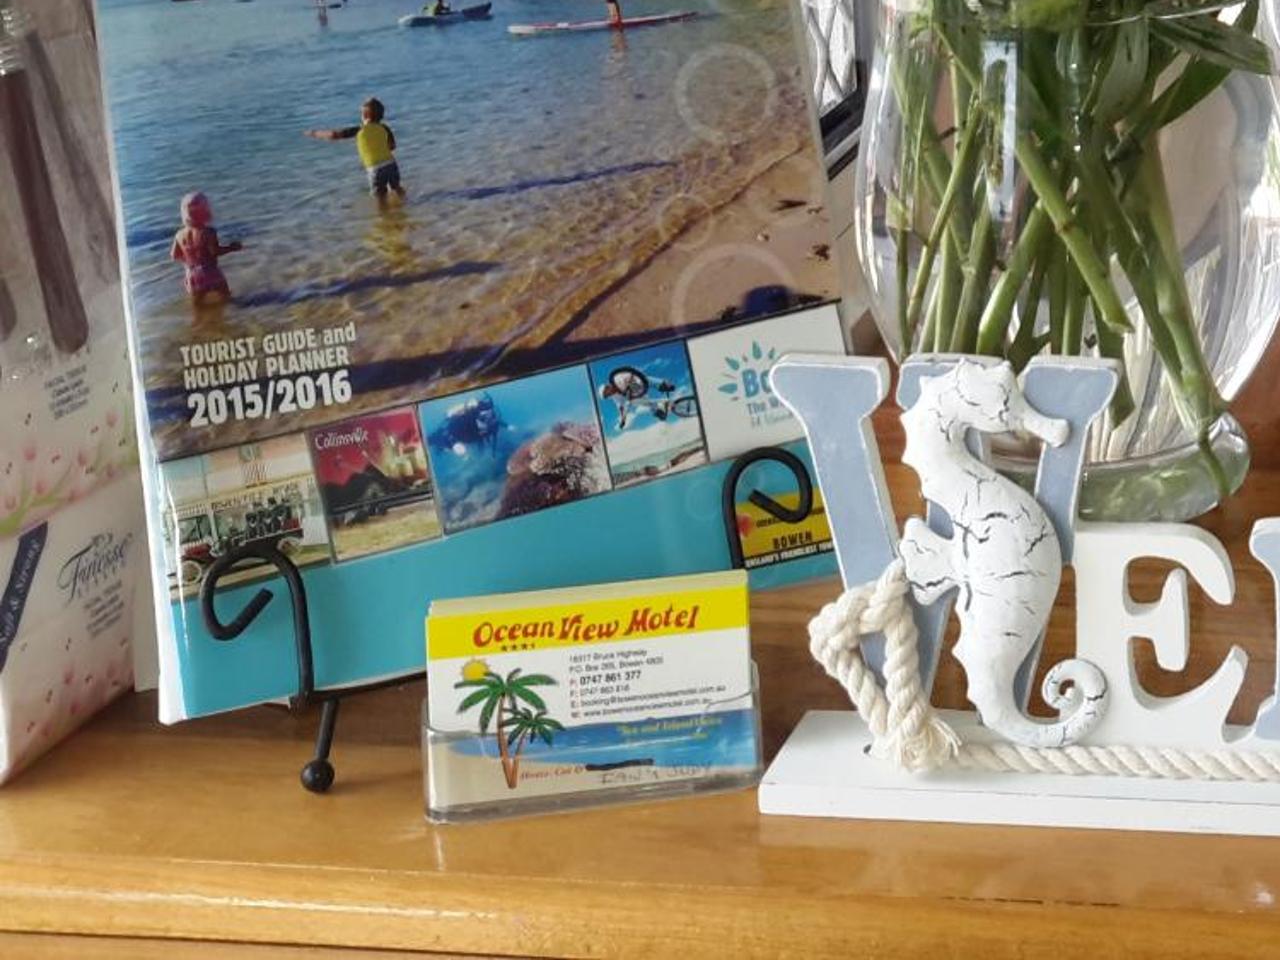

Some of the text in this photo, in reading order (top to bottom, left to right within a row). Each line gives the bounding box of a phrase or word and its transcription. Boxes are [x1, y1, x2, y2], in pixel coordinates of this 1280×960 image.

[180, 322, 356, 367] TOURIST GUIDE and
[184, 346, 350, 390] HOLIDAY PLANNER
[187, 370, 352, 428] 2015/2016
[473, 603, 700, 647] Ocean View Motel
[580, 676, 602, 686] 0747
[605, 672, 622, 682] 861
